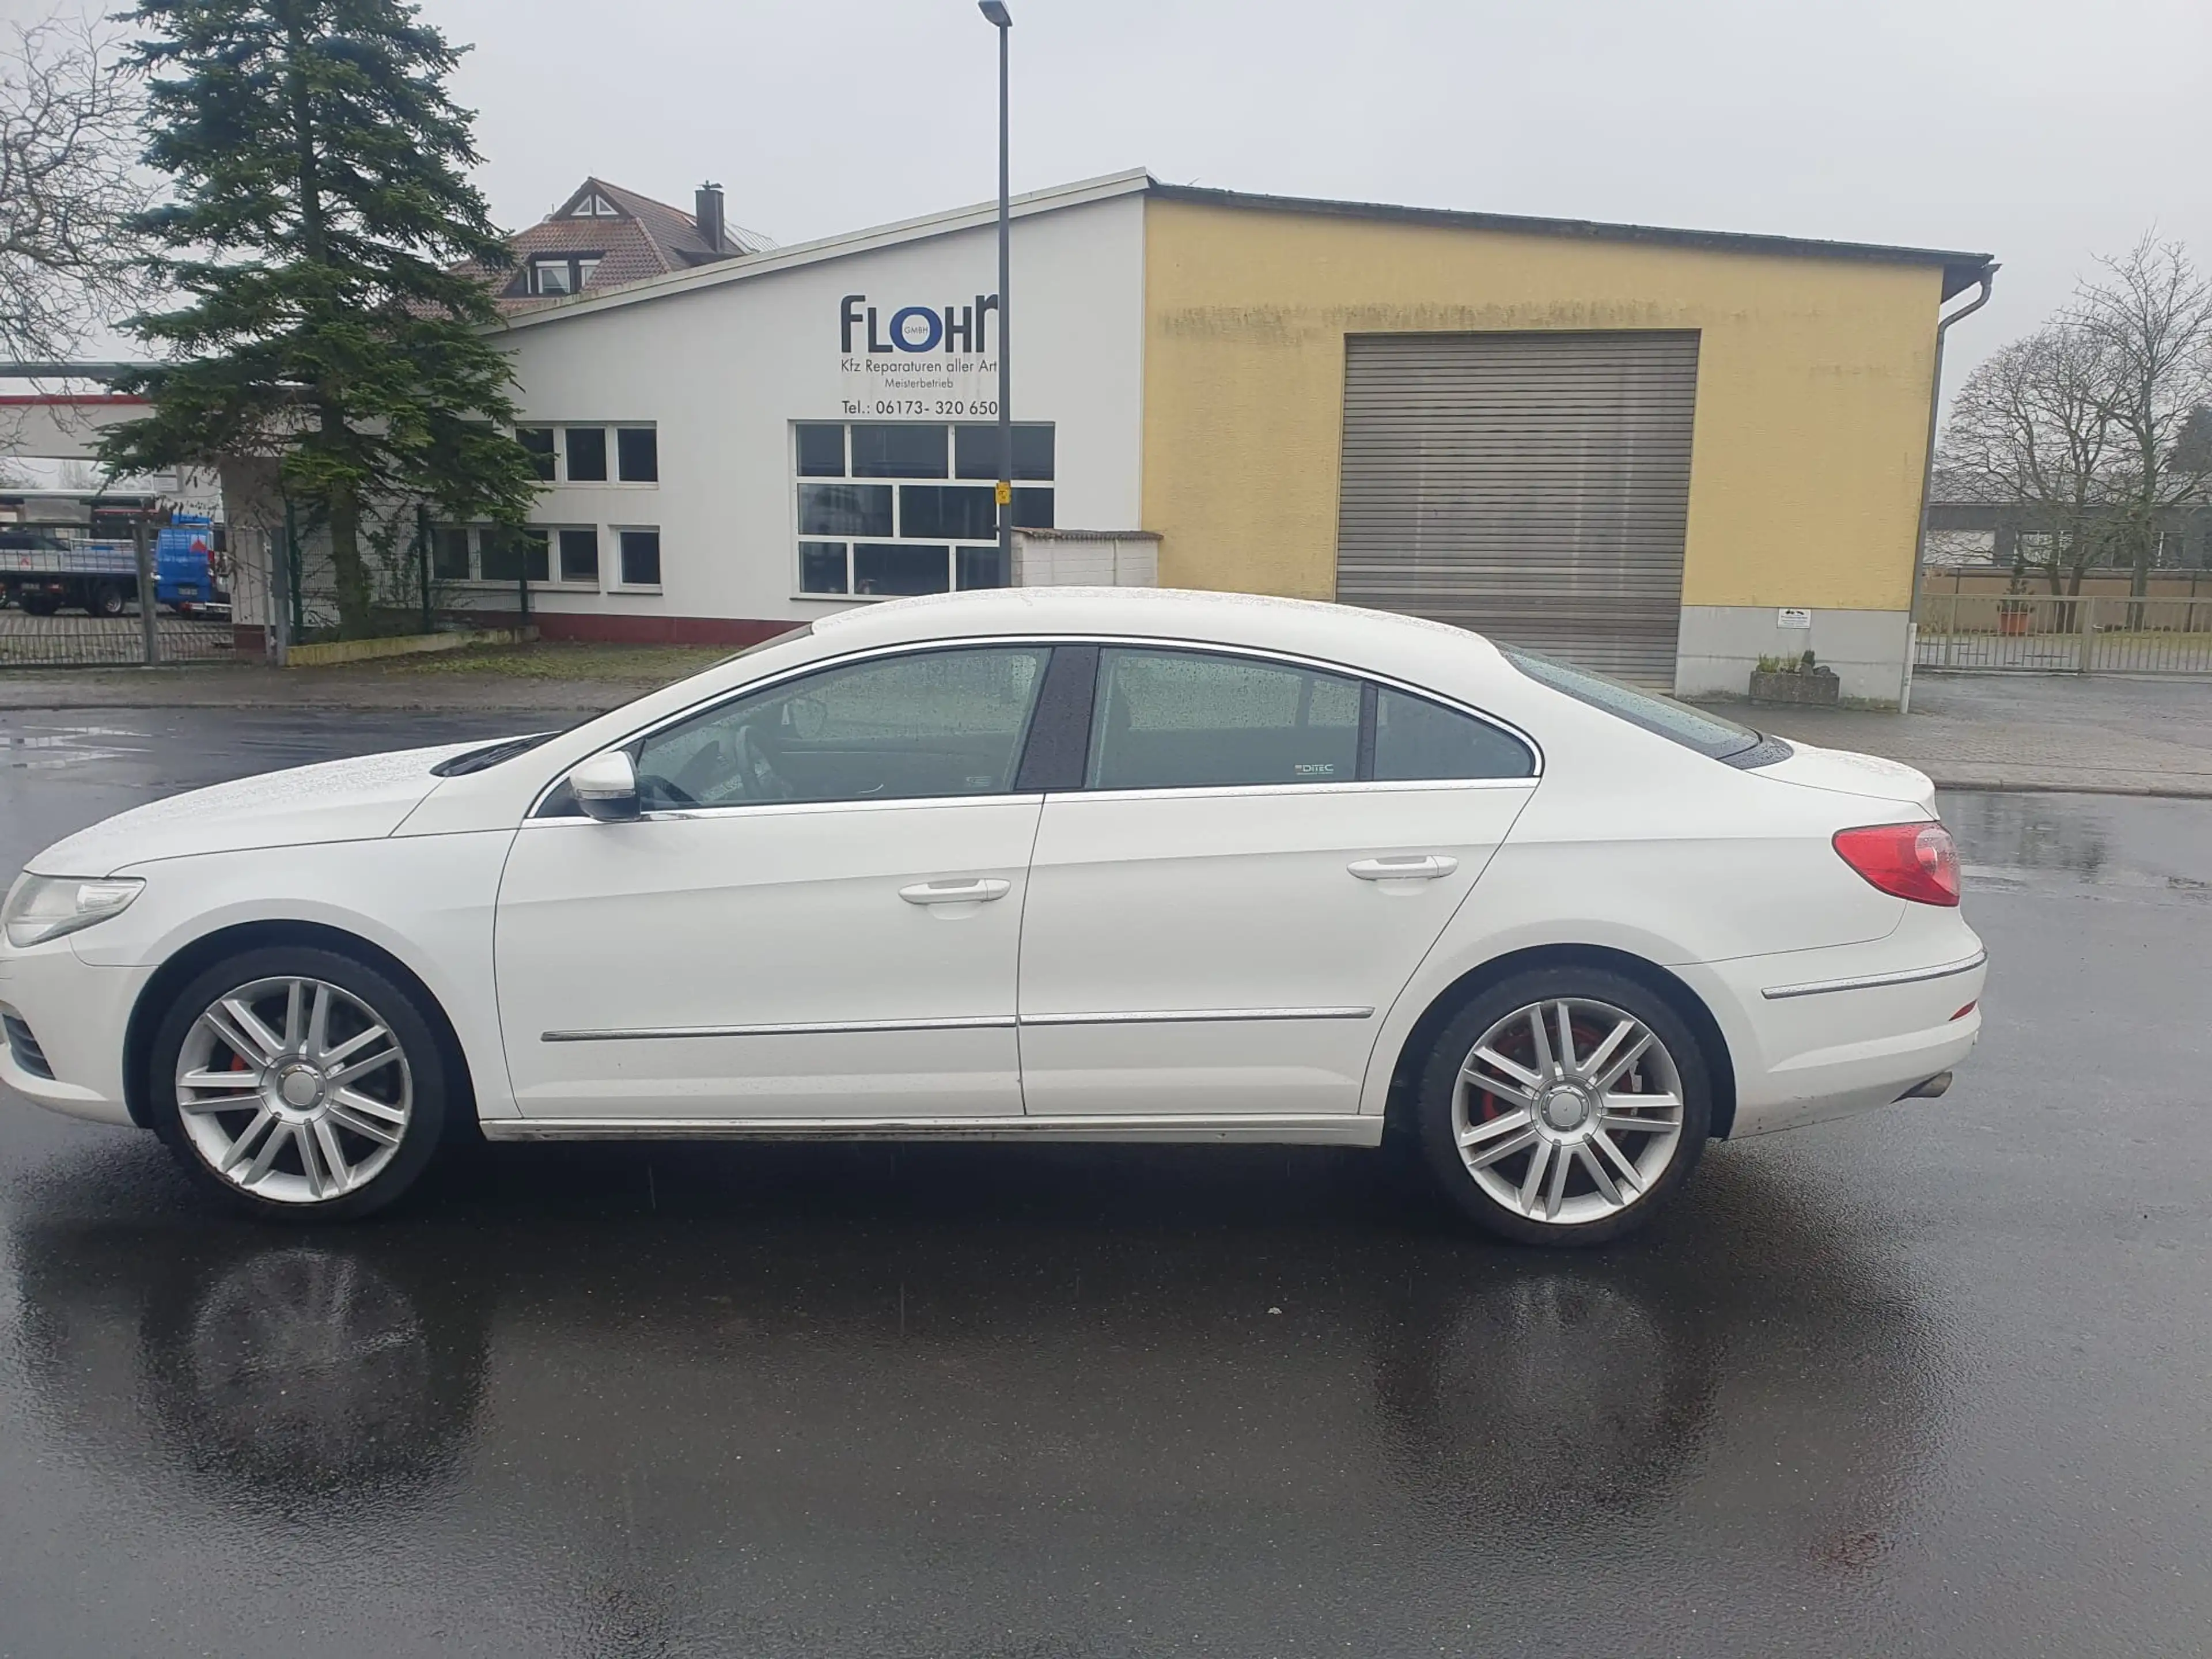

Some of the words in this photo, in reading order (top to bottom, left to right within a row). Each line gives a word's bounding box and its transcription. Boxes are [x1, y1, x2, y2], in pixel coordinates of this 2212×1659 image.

[841, 358, 861, 372] Kfz
[866, 359, 941, 375] Reparaturen
[946, 358, 974, 372] aller
[979, 359, 997, 372] Art
[885, 377, 953, 388] Meisterbetrieb
[842, 400, 870, 414] Tel.:
[876, 400, 929, 414] 06173-
[935, 401, 964, 415] 320
[969, 401, 998, 415] 650
